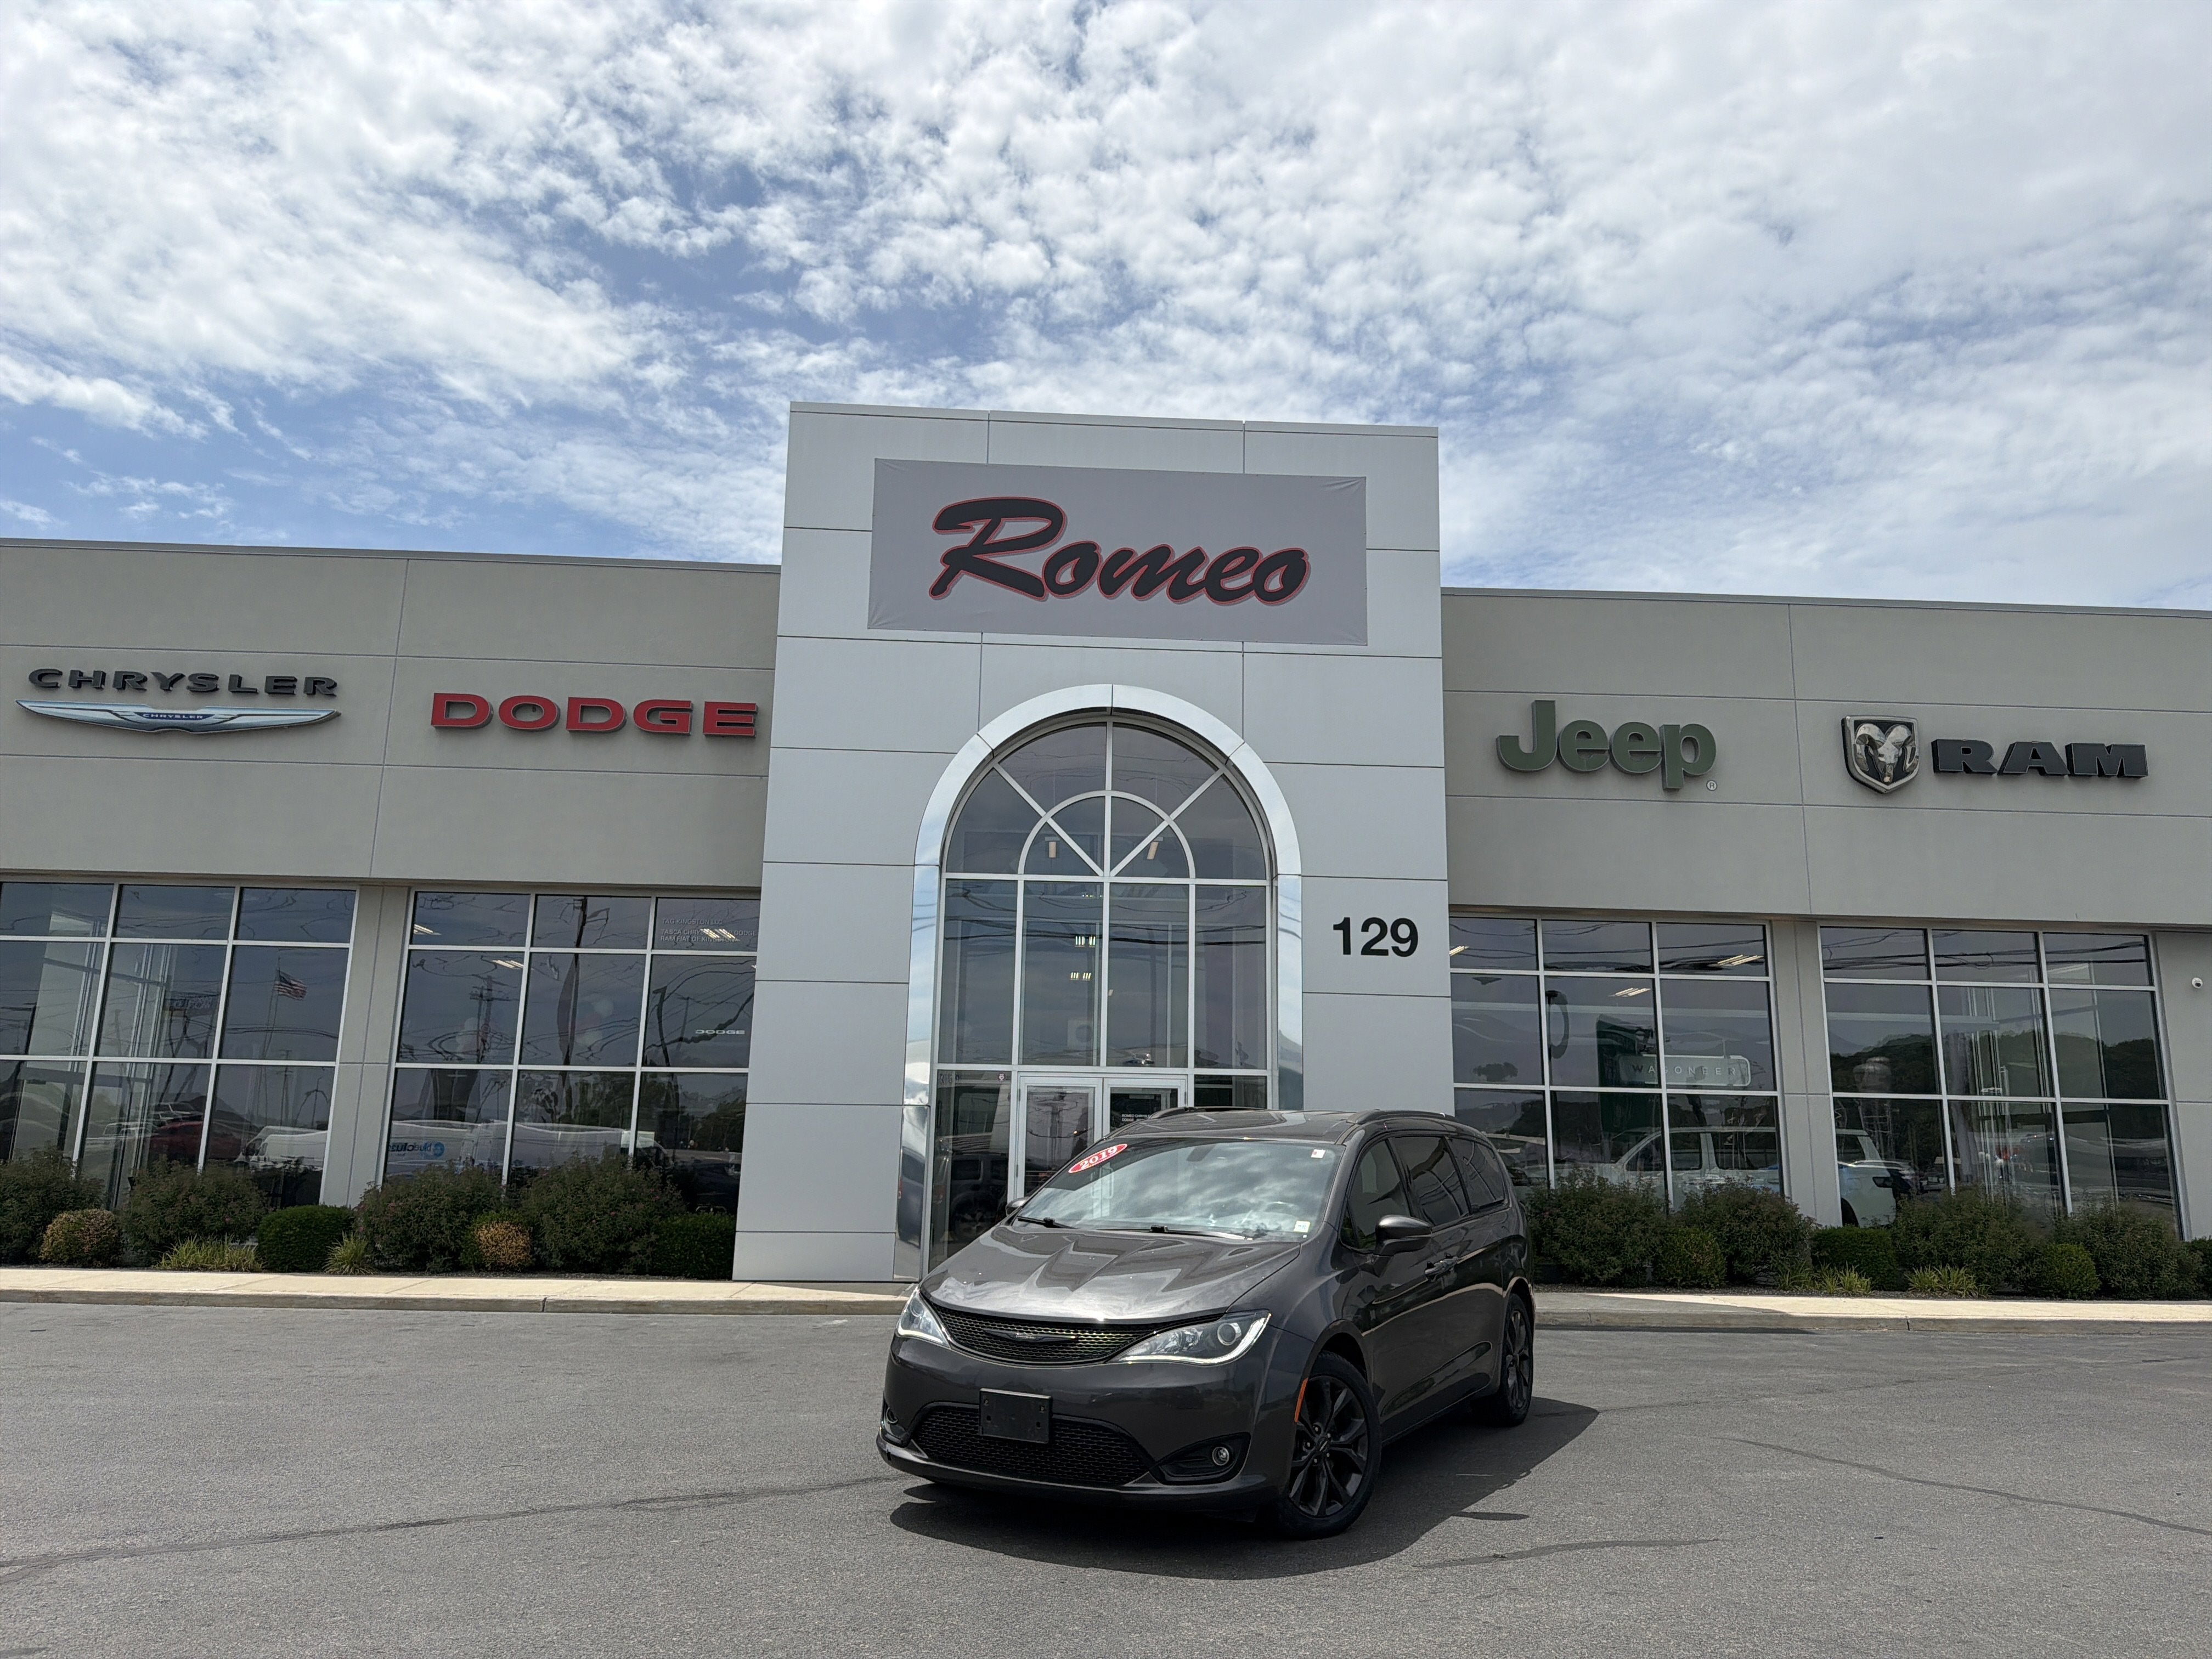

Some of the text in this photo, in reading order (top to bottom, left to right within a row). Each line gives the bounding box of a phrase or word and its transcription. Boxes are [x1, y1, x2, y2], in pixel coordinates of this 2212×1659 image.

[929, 496, 1310, 606] Romeo
[28, 668, 337, 697] CHRYSLER
[431, 692, 758, 738] DODGE
[1496, 699, 1716, 790] Jeep
[1931, 738, 2149, 777] RAM
[1333, 917, 1419, 957] 129
[1079, 1146, 1118, 1170] 2019
